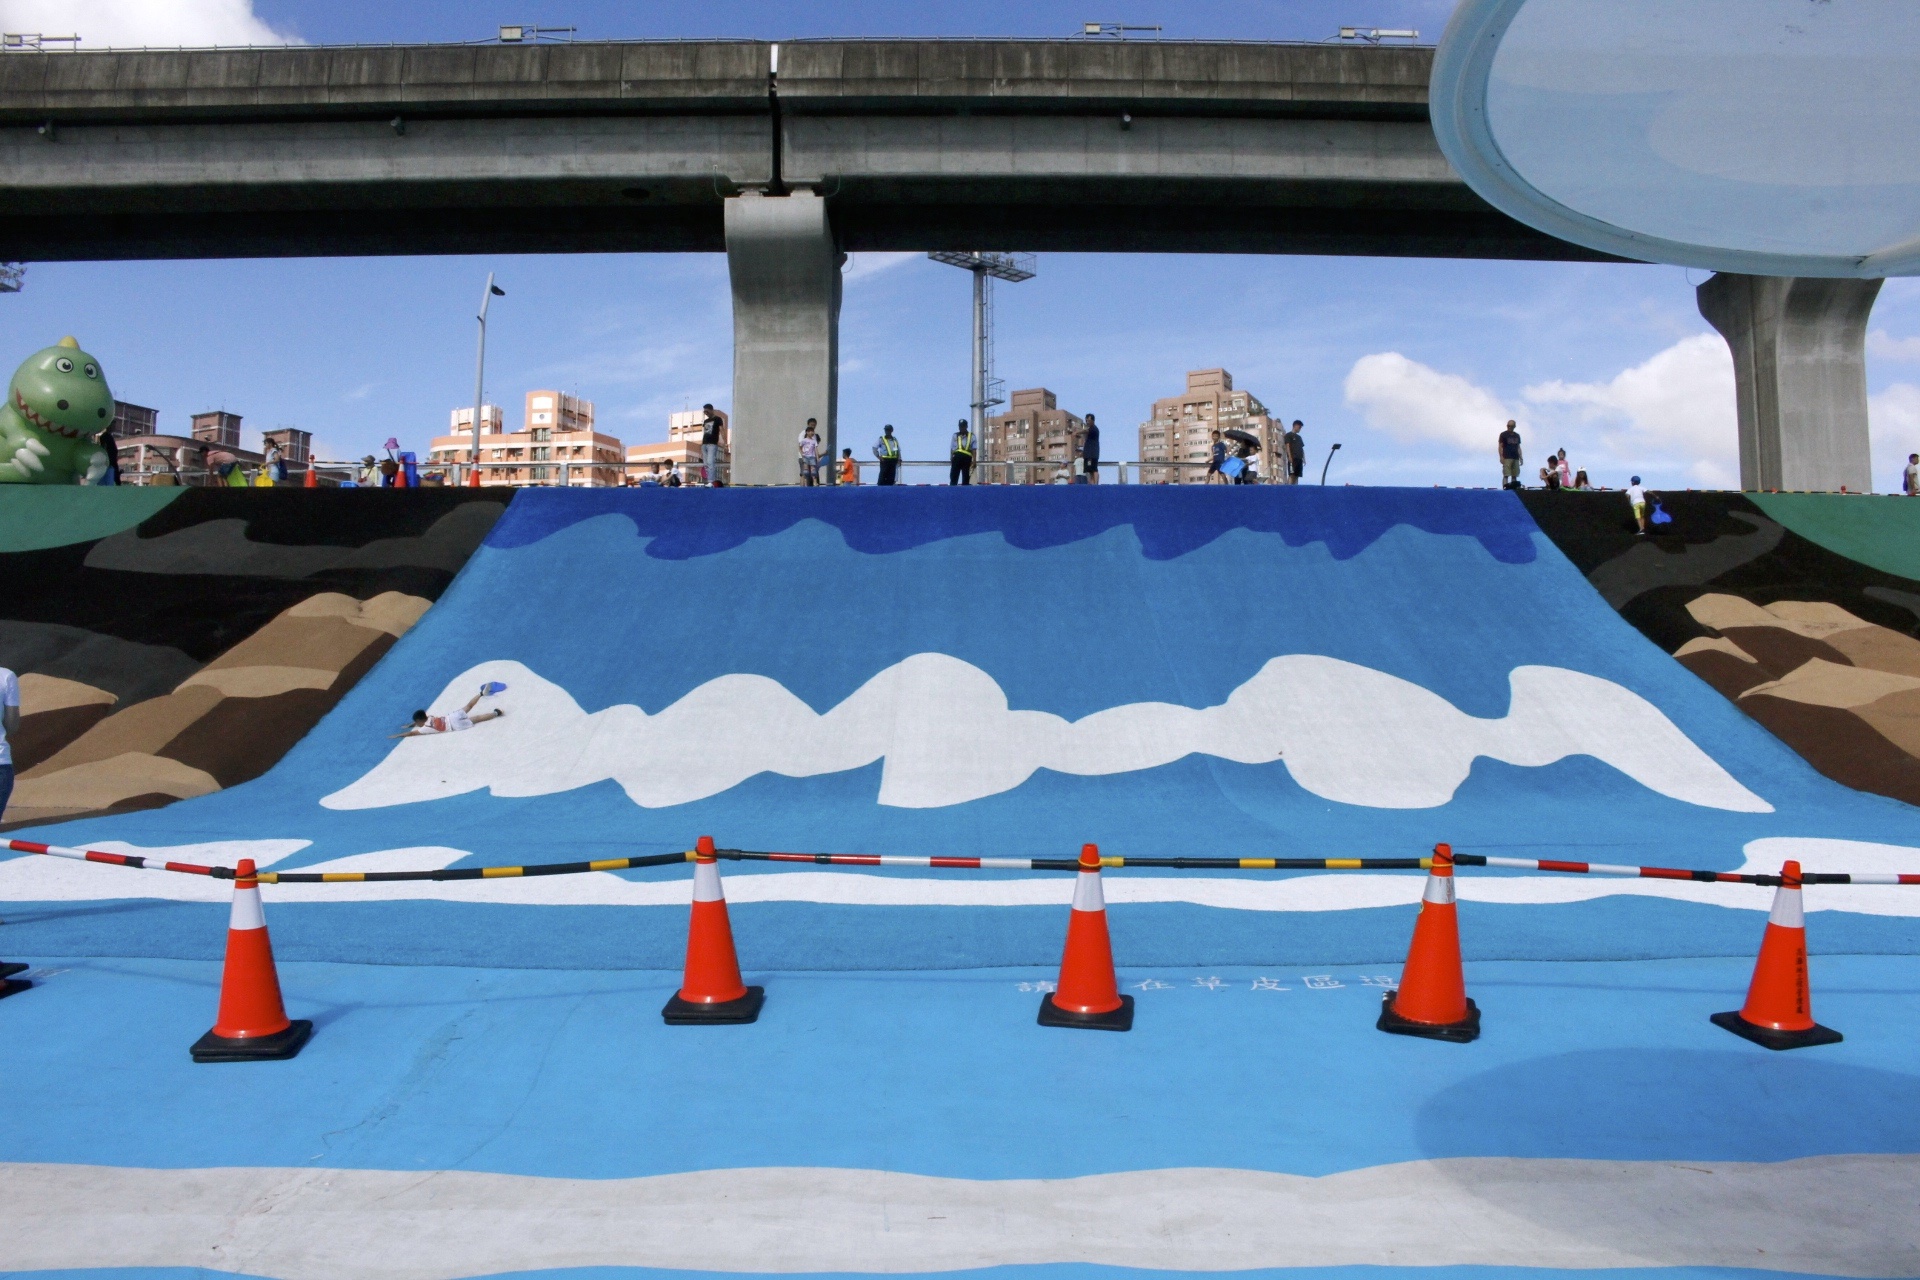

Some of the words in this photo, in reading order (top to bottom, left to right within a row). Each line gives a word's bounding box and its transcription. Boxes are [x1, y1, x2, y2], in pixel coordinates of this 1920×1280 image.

[1014, 974, 1400, 993] 請在草皮區逗
